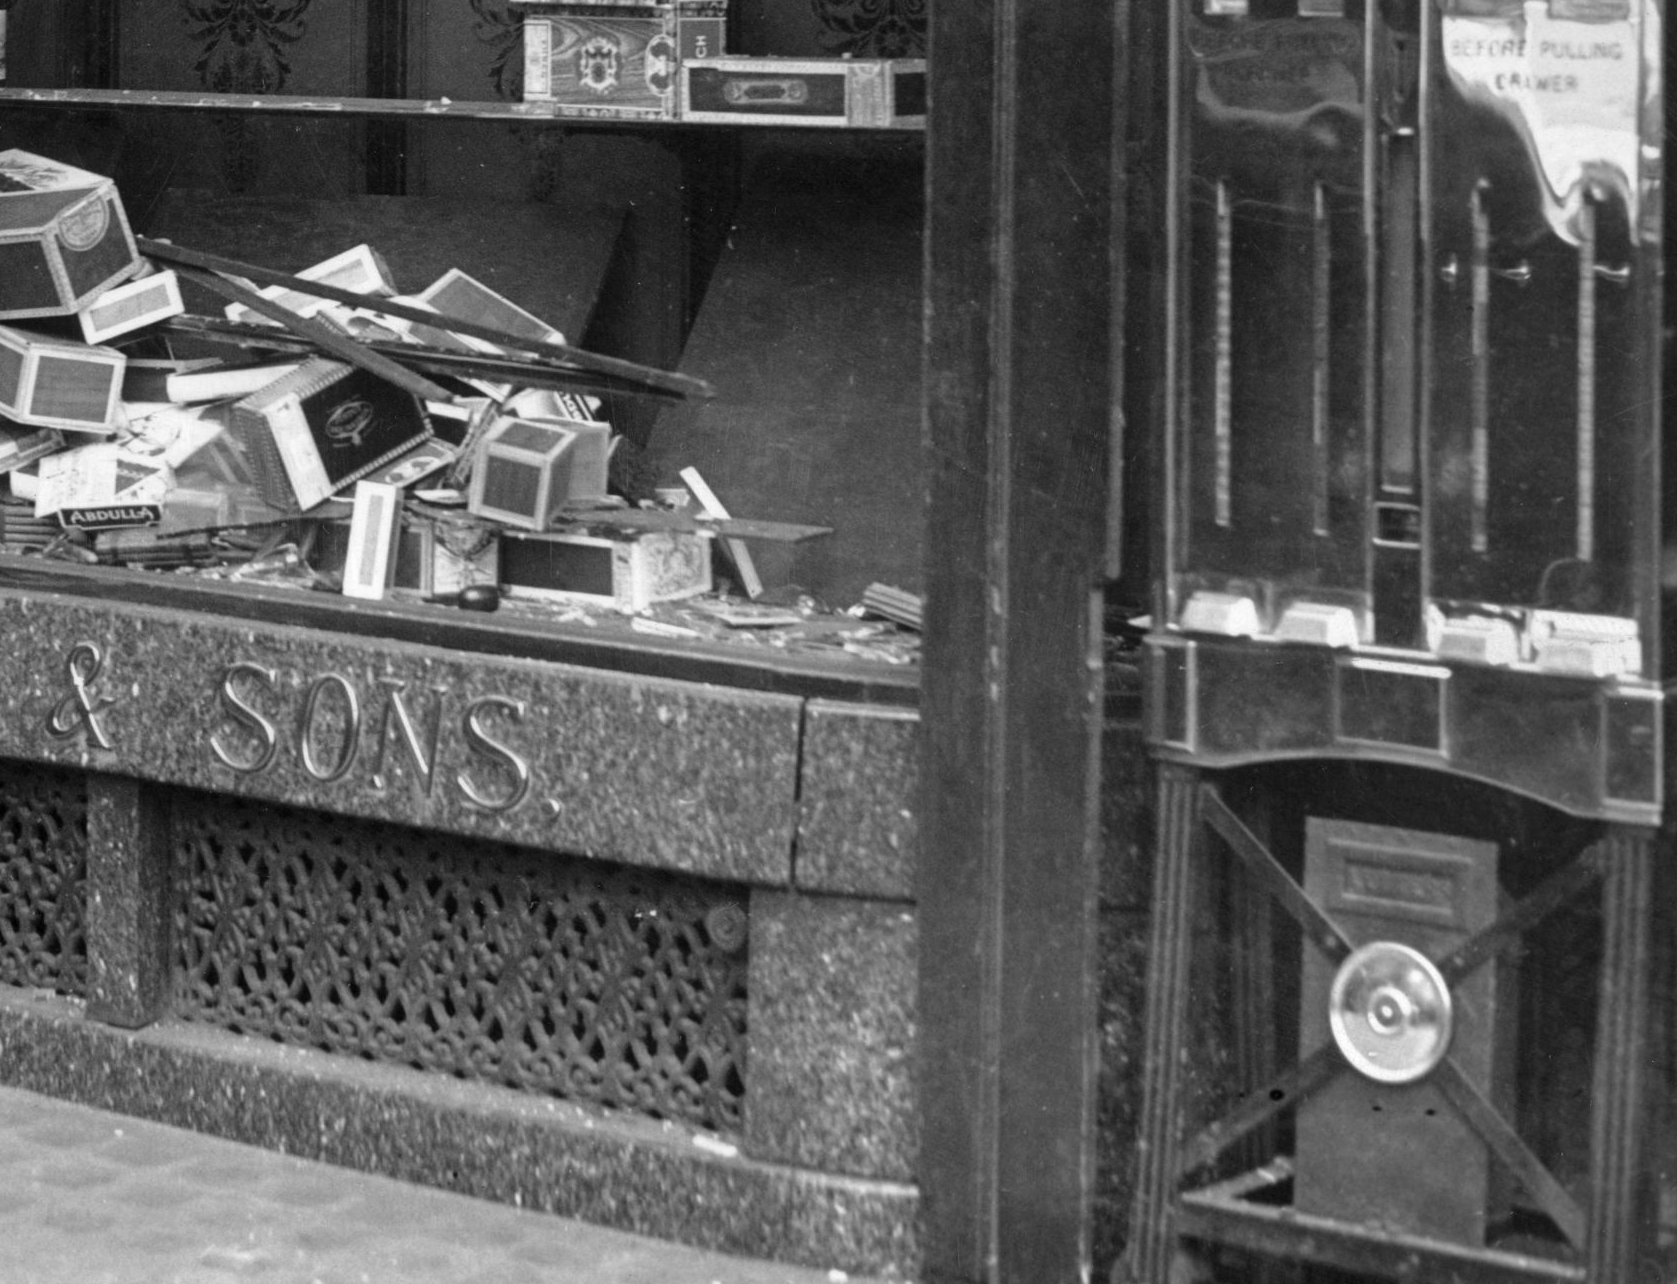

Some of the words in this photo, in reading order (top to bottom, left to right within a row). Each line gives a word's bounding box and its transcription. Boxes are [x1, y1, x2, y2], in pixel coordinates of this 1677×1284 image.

[1450, 37, 1528, 59] BEFORE
[1538, 39, 1623, 62] PULLING
[70, 506, 155, 524] ABDULLA
[46, 641, 117, 751] &
